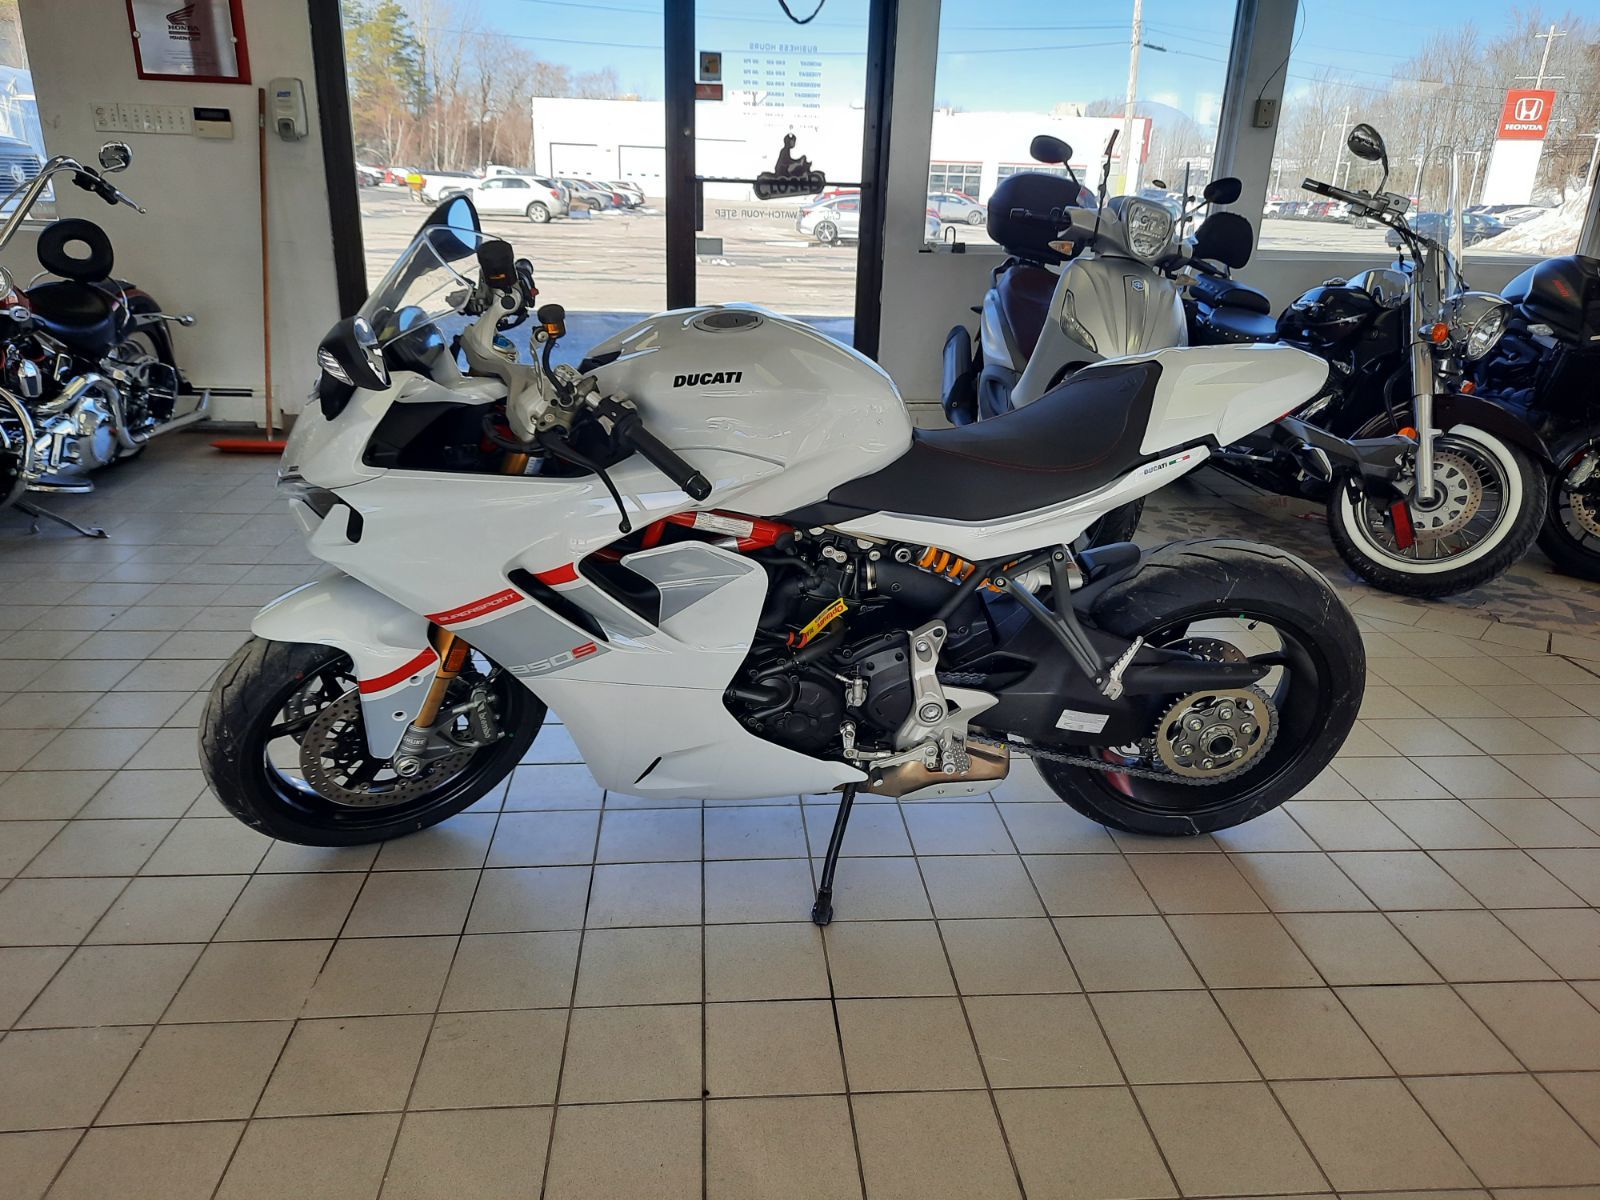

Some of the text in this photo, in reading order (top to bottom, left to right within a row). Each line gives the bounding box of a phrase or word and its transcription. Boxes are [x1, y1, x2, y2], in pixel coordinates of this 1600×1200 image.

[673, 372, 742, 388] DUCATI
[1143, 462, 1168, 475] DUCATI
[438, 592, 515, 622] SUPERSPORT
